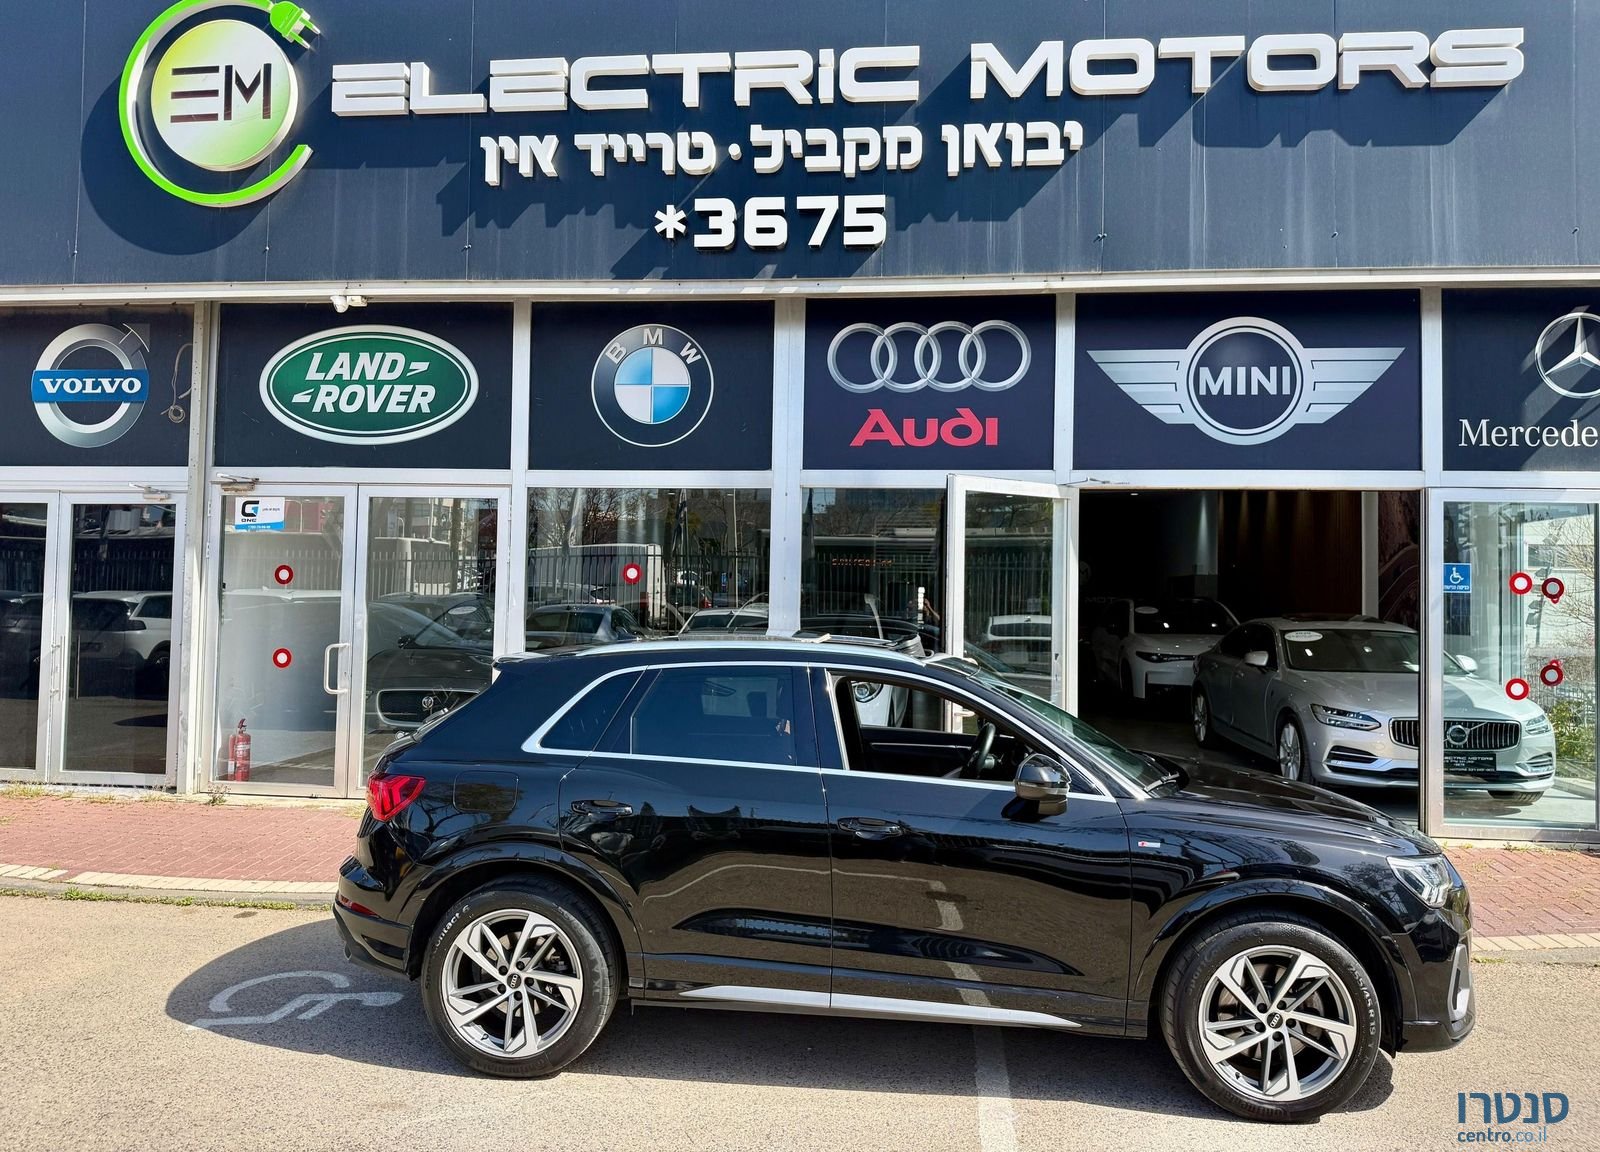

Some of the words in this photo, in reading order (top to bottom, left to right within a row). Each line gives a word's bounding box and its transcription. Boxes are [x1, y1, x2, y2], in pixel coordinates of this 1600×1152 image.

[170, 62, 272, 124] EM
[330, 45, 920, 117] ELECTRIC
[970, 26, 1525, 99] MOTORS
[480, 133, 559, 187] אין
[574, 129, 717, 177] טרייד
[751, 122, 923, 180] מקביל
[941, 119, 1084, 178] יבואן
[304, 352, 402, 381] LAND
[604, 326, 703, 366] BMW
[39, 376, 142, 396] VOLVO
[311, 384, 436, 414] ROVER
[1198, 366, 1293, 397] MINI
[849, 408, 999, 447] Audi
